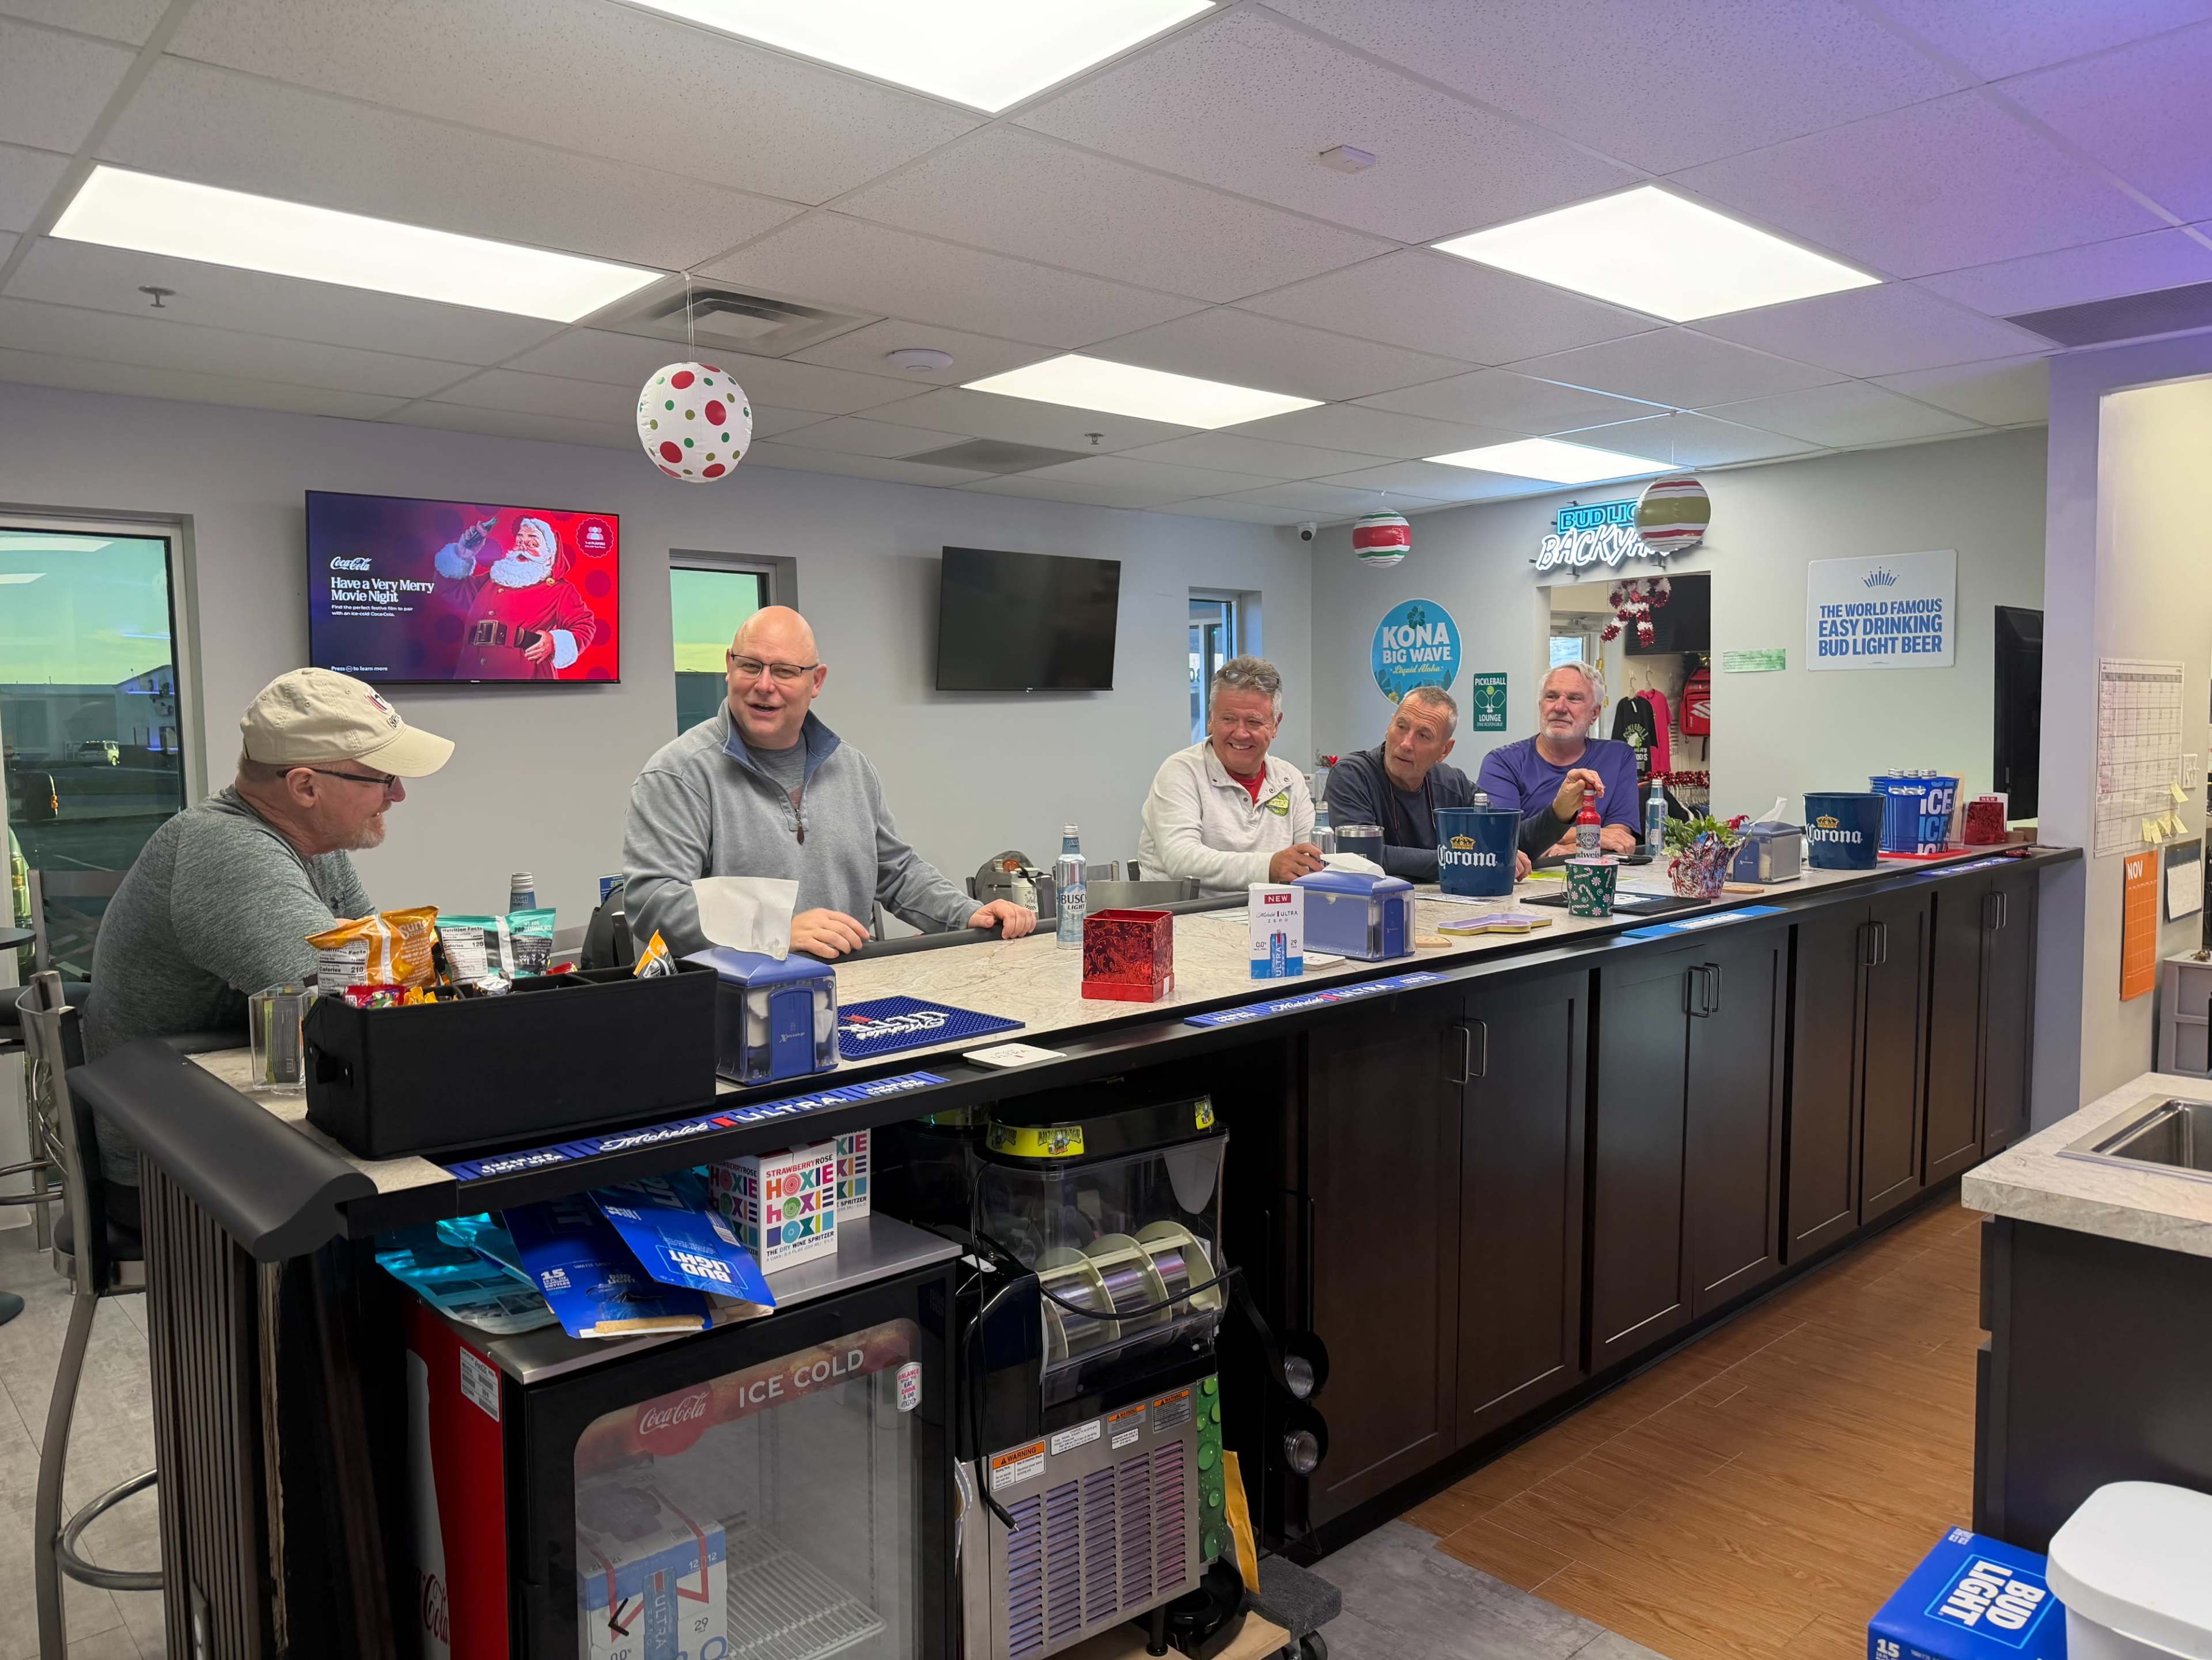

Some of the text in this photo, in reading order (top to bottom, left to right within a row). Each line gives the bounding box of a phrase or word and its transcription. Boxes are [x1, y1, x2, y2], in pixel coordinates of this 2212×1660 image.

[1562, 506, 1606, 529] BUD
[330, 556, 372, 571] Coca-Cola
[331, 577, 435, 594] Have a Very Merry
[331, 589, 399, 604] Movie Night
[1820, 598, 1942, 618] THE WORLD FAMOUS
[1382, 622, 1450, 649] KONA
[1819, 614, 1942, 638] EASY DRINKING
[1383, 646, 1451, 664] BIG WAVE
[1819, 634, 1942, 656] BUD LIGHT BEER
[1392, 664, 1441, 675] Liquid Aloha
[1475, 678, 1506, 686] PICKLEBALL
[1919, 788, 1953, 815] ICE
[1806, 822, 1862, 845] Corona
[1437, 844, 1497, 870] Corona
[2127, 859, 2143, 880] NOV
[1268, 895, 1288, 903] NEW
[1270, 985, 1394, 1012] Michelob ULTRA
[599, 1096, 847, 1152] Michelob ULTRA
[766, 1163, 834, 1201] HOXIE
[840, 1196, 867, 1207] SPRITZER
[766, 1231, 835, 1257] THE DRY WINE SPRITZER
[668, 1249, 730, 1273] LIGHT
[541, 1268, 566, 1280] 15
[680, 1262, 732, 1284] BUD
[739, 1349, 864, 1408] ICE COLD
[898, 1368, 919, 1380] BALANCE
[901, 1385, 916, 1394] DRINK
[639, 1391, 710, 1435] Coca-Cola
[1007, 1447, 1037, 1462] WARNING
[688, 1552, 717, 1569] 12 12
[1940, 1560, 2014, 1627] LIGHT
[1985, 1579, 2047, 1630] BUD
[654, 1594, 667, 1650] ULTRA
[694, 1617, 709, 1632] 29
[1877, 1639, 1900, 1659] 15
